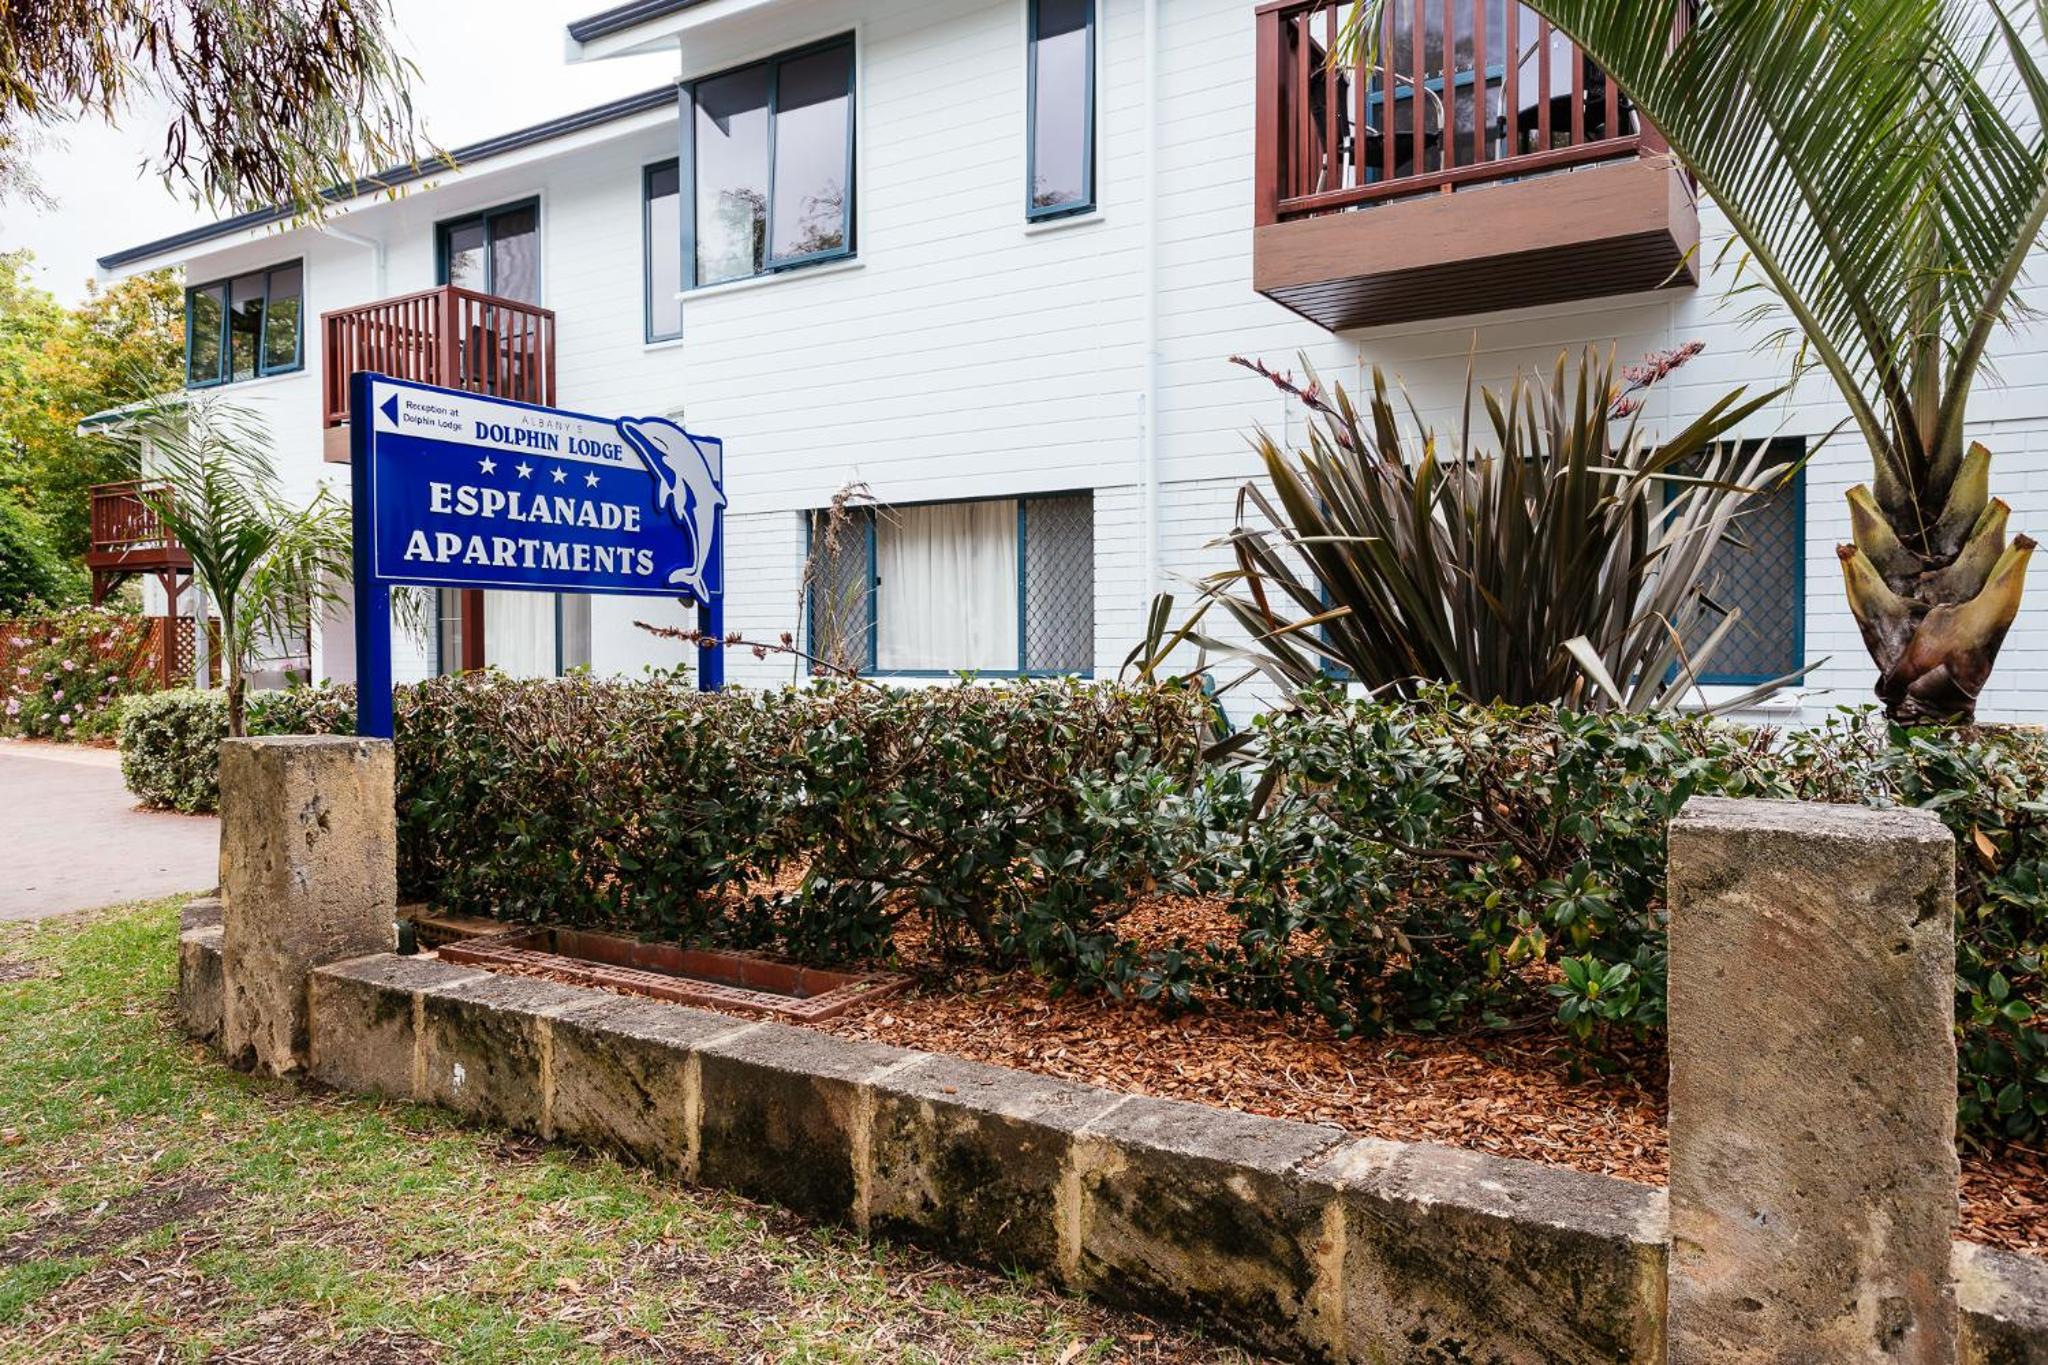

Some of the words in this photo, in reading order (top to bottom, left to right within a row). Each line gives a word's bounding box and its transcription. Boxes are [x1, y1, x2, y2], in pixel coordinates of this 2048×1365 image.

[403, 413, 435, 426] Dolphin
[438, 419, 463, 432] Lodge
[406, 400, 448, 416] Reception
[450, 408, 459, 417] at
[522, 415, 583, 434] ALBANY'S
[475, 421, 559, 451] DOLPHIN
[568, 436, 623, 461] LODGE
[429, 481, 641, 533] ESPLANADE
[403, 529, 654, 576] APARTMENTS
